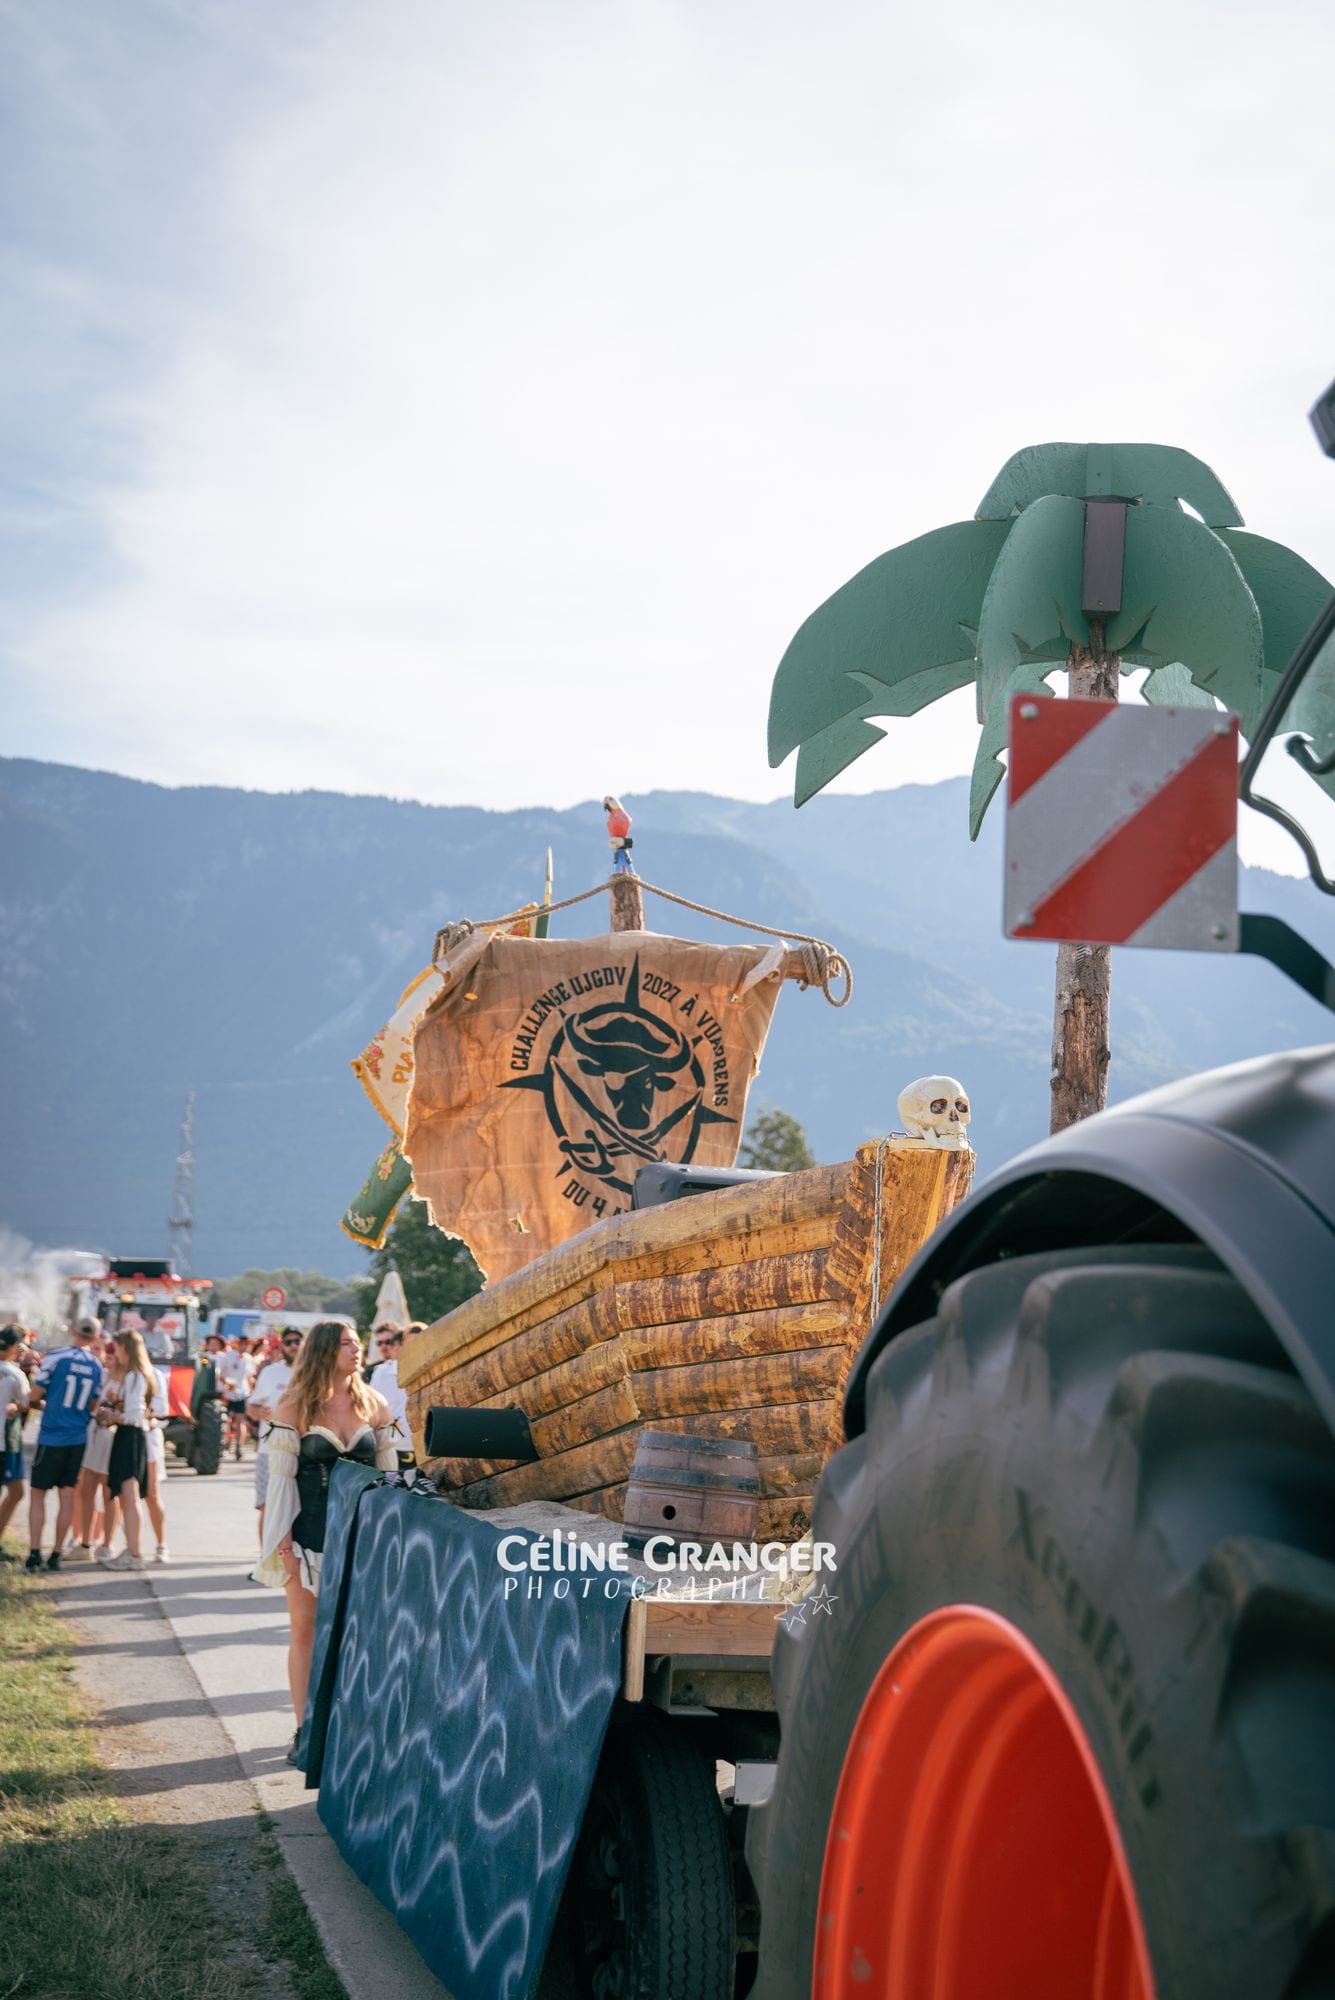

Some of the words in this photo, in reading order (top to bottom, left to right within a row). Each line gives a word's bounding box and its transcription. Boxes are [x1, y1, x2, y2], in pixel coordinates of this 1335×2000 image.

[510, 982, 571, 1071] CHALLENGE
[569, 966, 626, 996] UJGDV
[642, 972, 681, 1003] 2027
[679, 993, 699, 1017] À
[562, 1179, 591, 1207] DU
[592, 1196, 607, 1218] 4
[63, 1375, 93, 1410] 11
